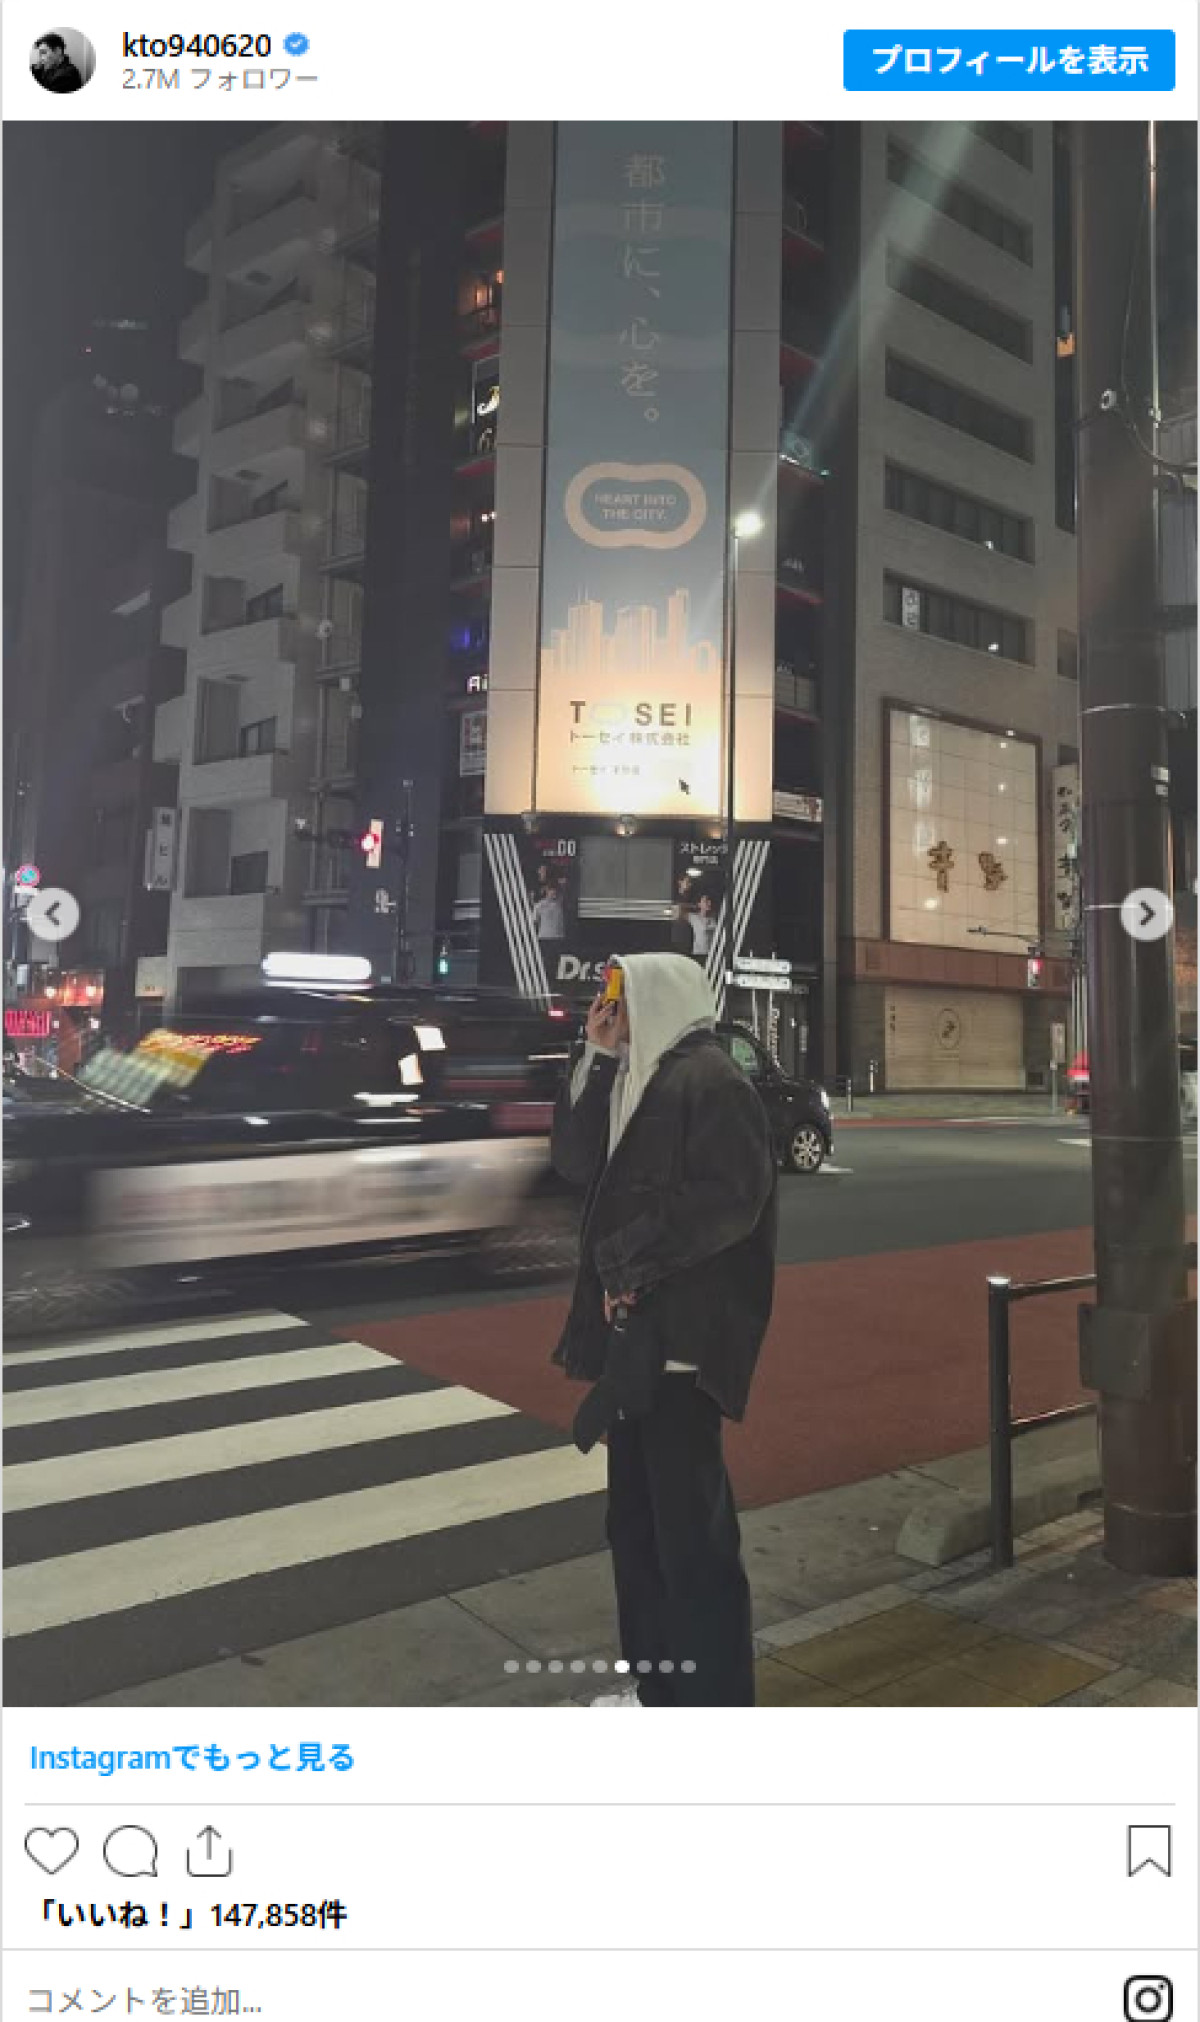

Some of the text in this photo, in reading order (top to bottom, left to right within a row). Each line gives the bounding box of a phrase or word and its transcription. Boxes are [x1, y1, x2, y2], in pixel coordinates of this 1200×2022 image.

[617, 152, 665, 422] 都市に、心を。
[602, 508, 631, 520] THE
